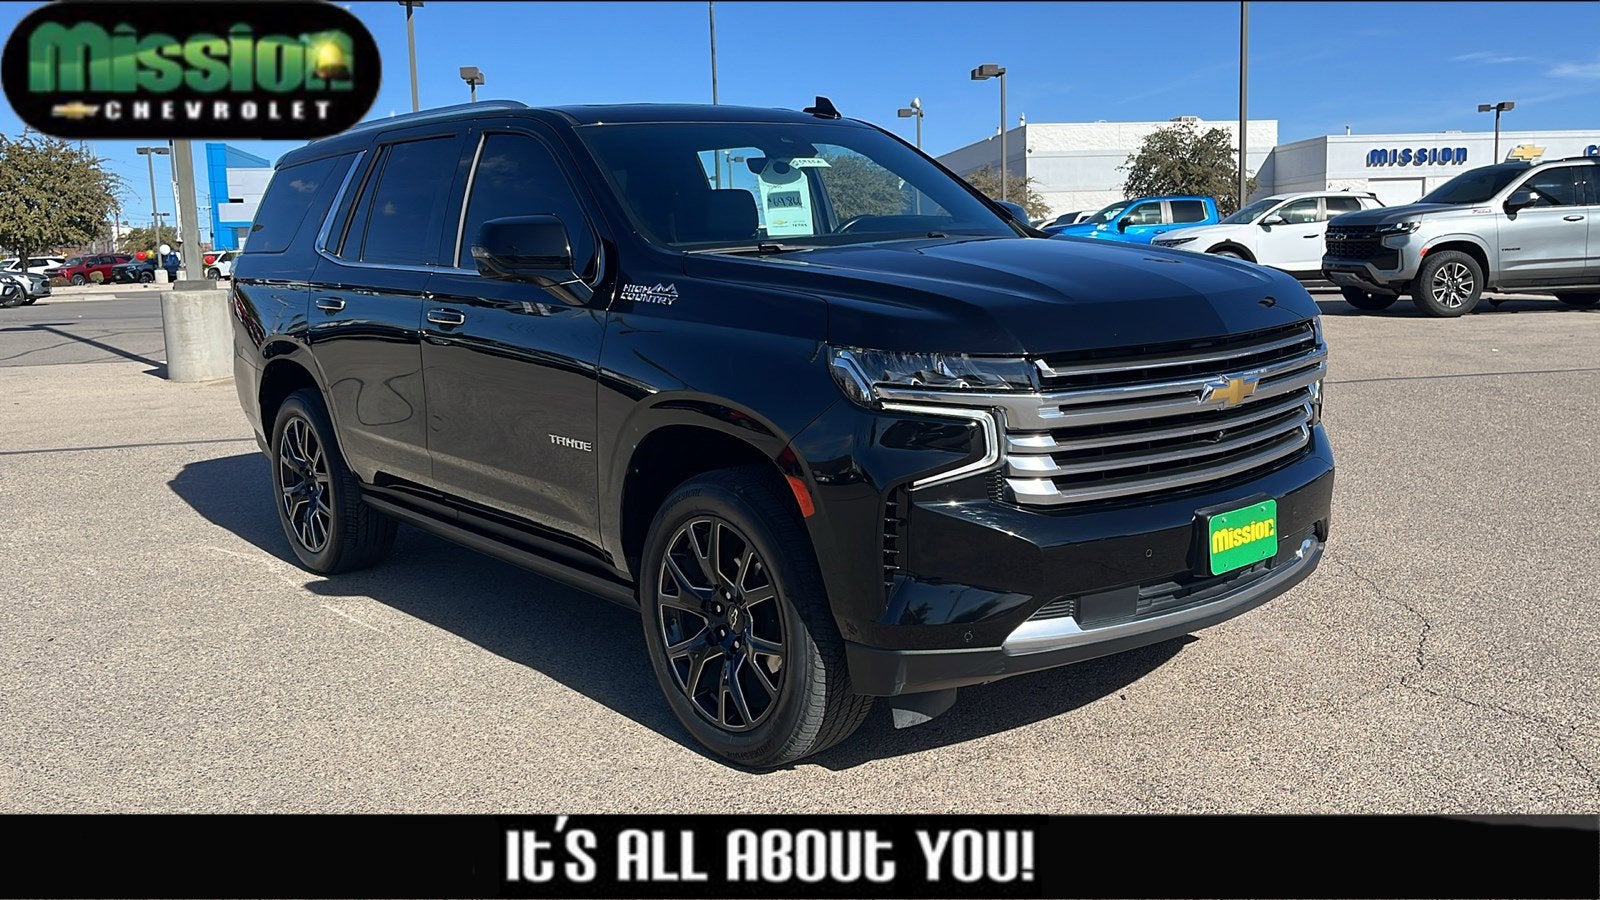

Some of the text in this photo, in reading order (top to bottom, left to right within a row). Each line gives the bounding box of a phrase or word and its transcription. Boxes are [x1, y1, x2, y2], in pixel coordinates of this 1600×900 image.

[1366, 147, 1467, 167] MISSION
[622, 283, 652, 294] HIGH
[620, 292, 678, 305] COUNTRY
[549, 434, 592, 452] TAHOE
[1212, 518, 1275, 554] Mission
